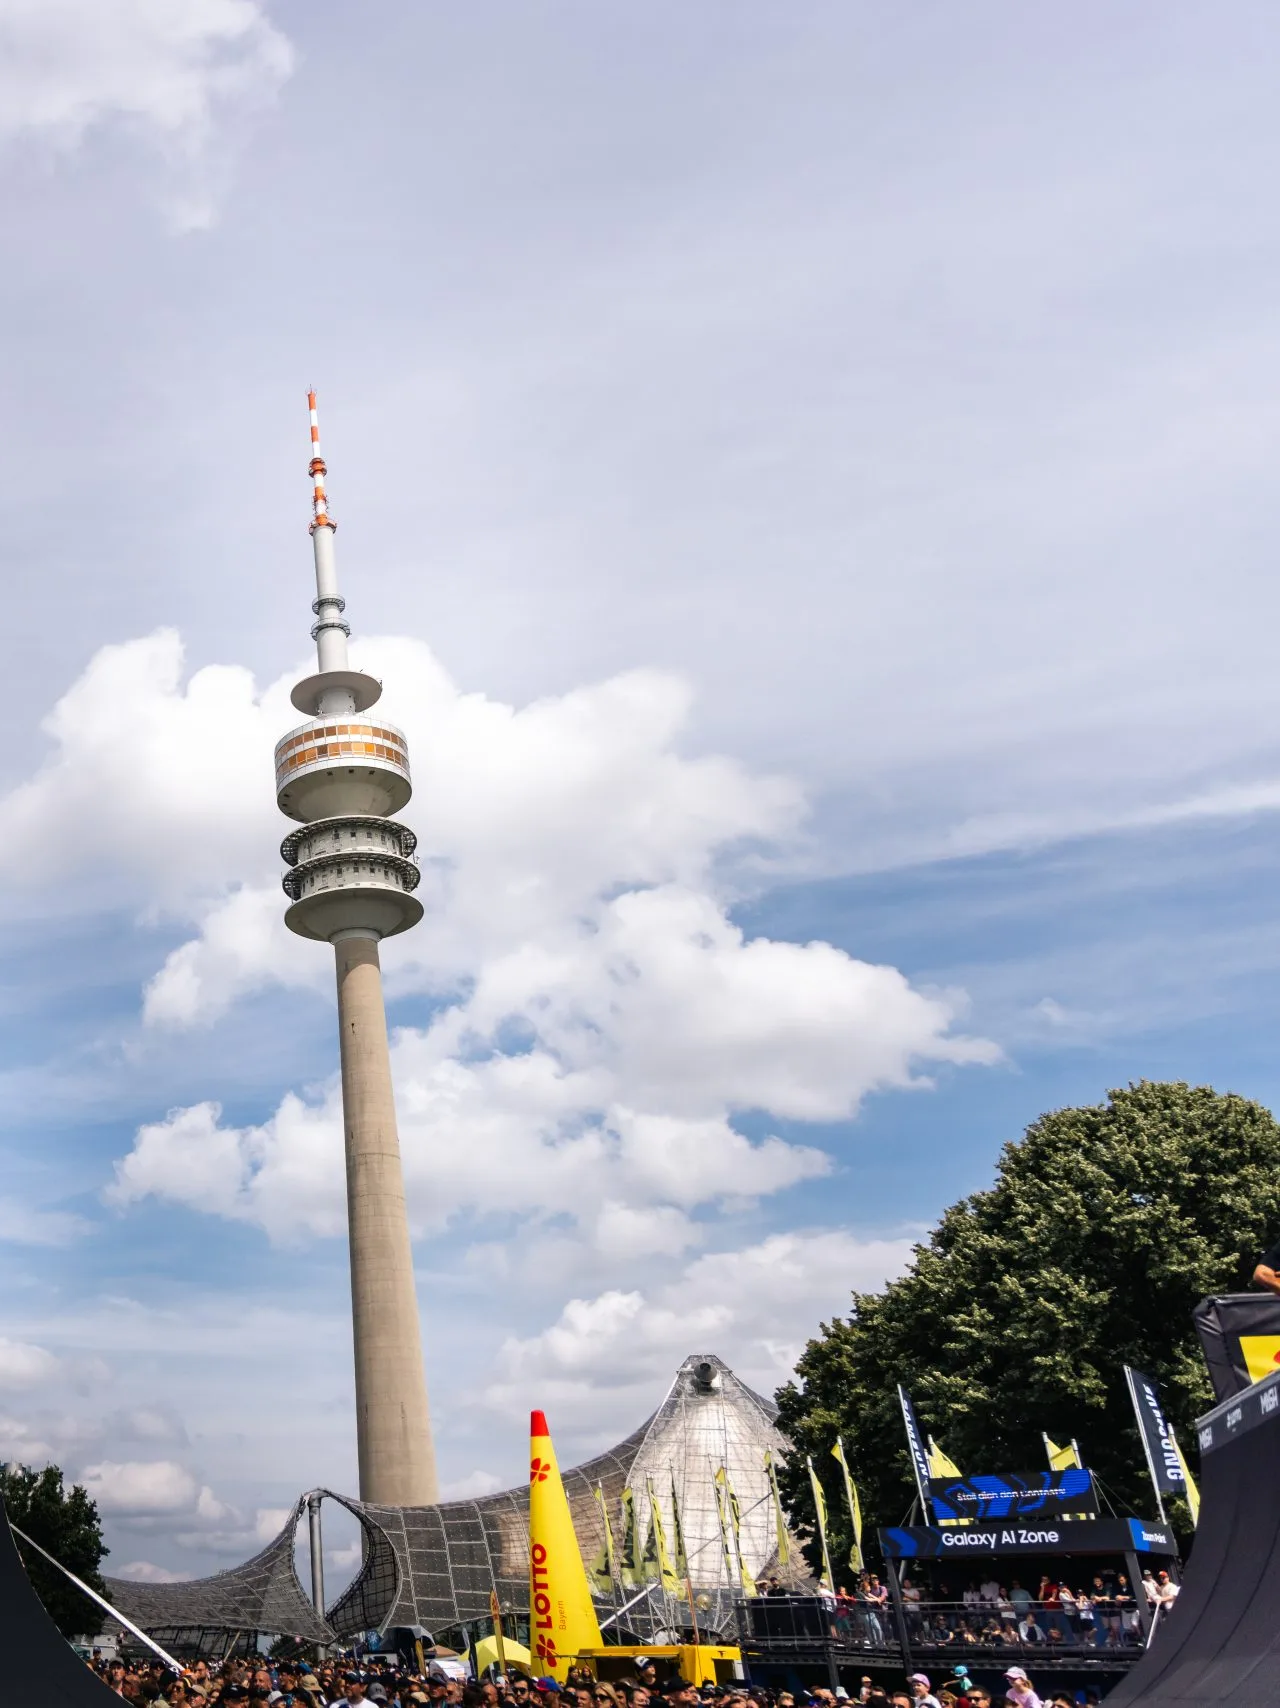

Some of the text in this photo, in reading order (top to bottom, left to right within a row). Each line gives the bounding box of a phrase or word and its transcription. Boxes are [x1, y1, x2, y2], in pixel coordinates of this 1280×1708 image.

[941, 1529, 1060, 1549] Galaxy AI Zone
[531, 1543, 554, 1630] LOTTO
[558, 1600, 567, 1631] Bayern
